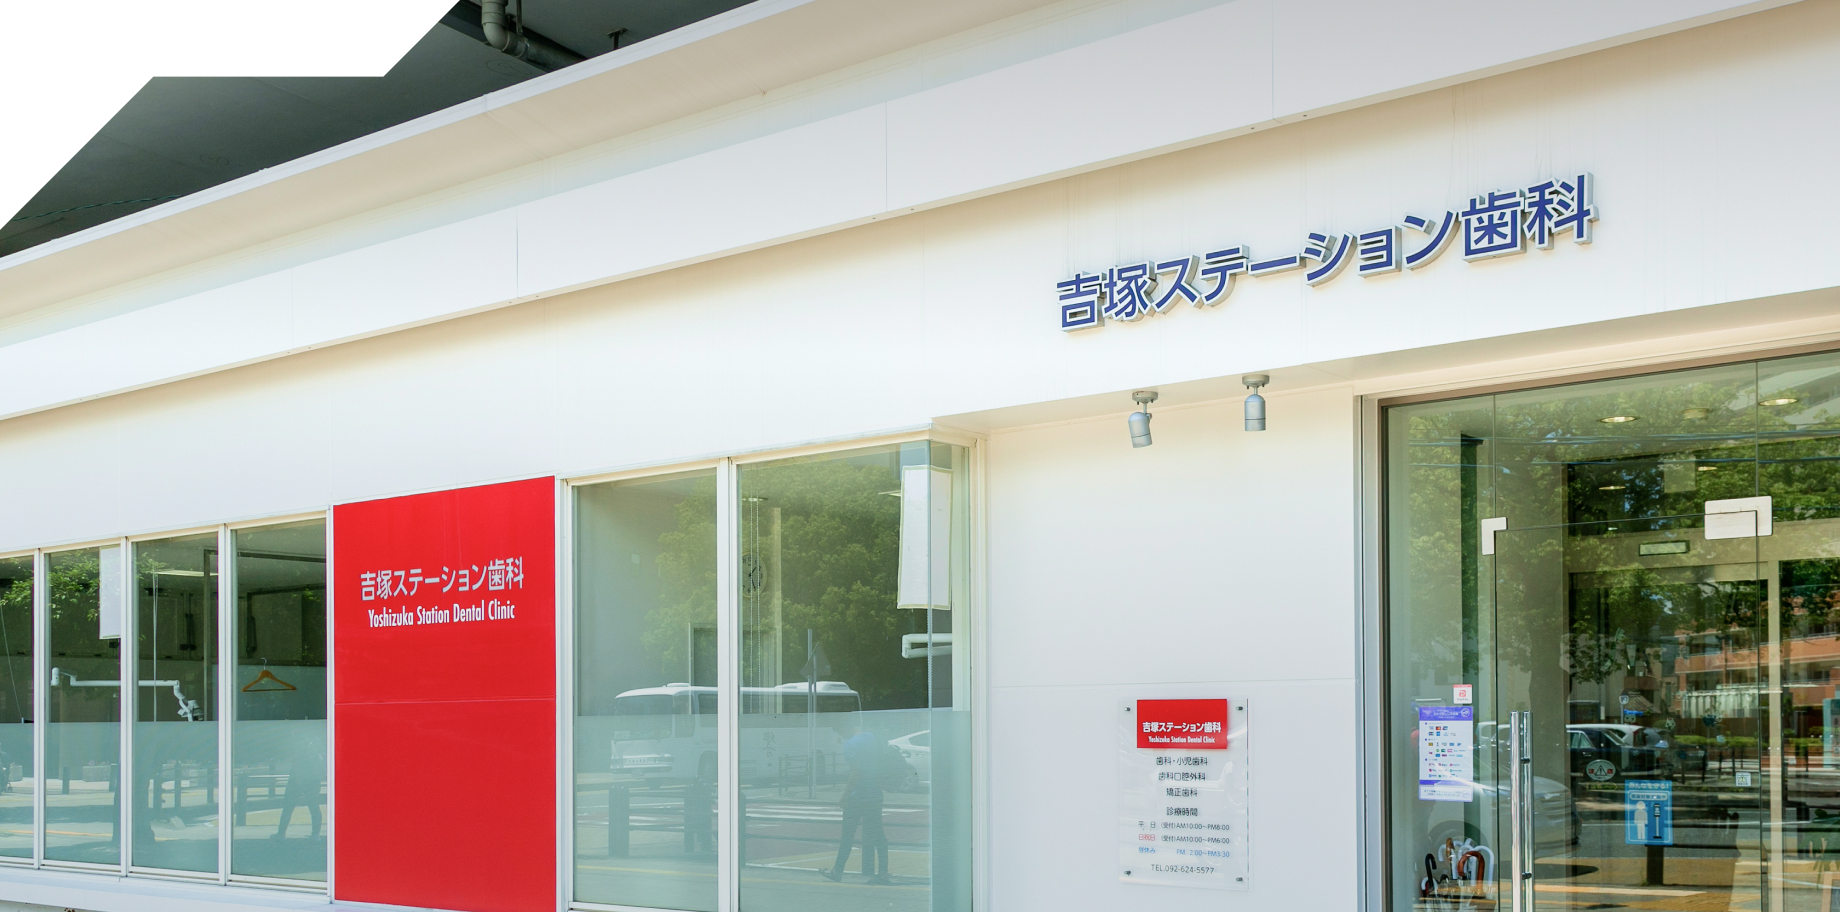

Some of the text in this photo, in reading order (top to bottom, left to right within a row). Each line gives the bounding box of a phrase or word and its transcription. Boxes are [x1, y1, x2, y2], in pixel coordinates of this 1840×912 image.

[1056, 173, 1597, 332] 吉塚ステーション歯科
[360, 556, 524, 601] 吉塚ステーション歯科
[368, 599, 515, 628] Yoshizuka Station Dental Clinic
[1142, 721, 1221, 733] 吉塚ステーション歯科
[1148, 735, 1215, 743] Yoshizuka Station Dental Clinic
[1156, 756, 1208, 766] 歯科・小児歯科
[1158, 772, 1206, 781] 歯科口腔外科
[1166, 787, 1198, 797] 矯正歯科
[1166, 806, 1198, 817] 診療時間
